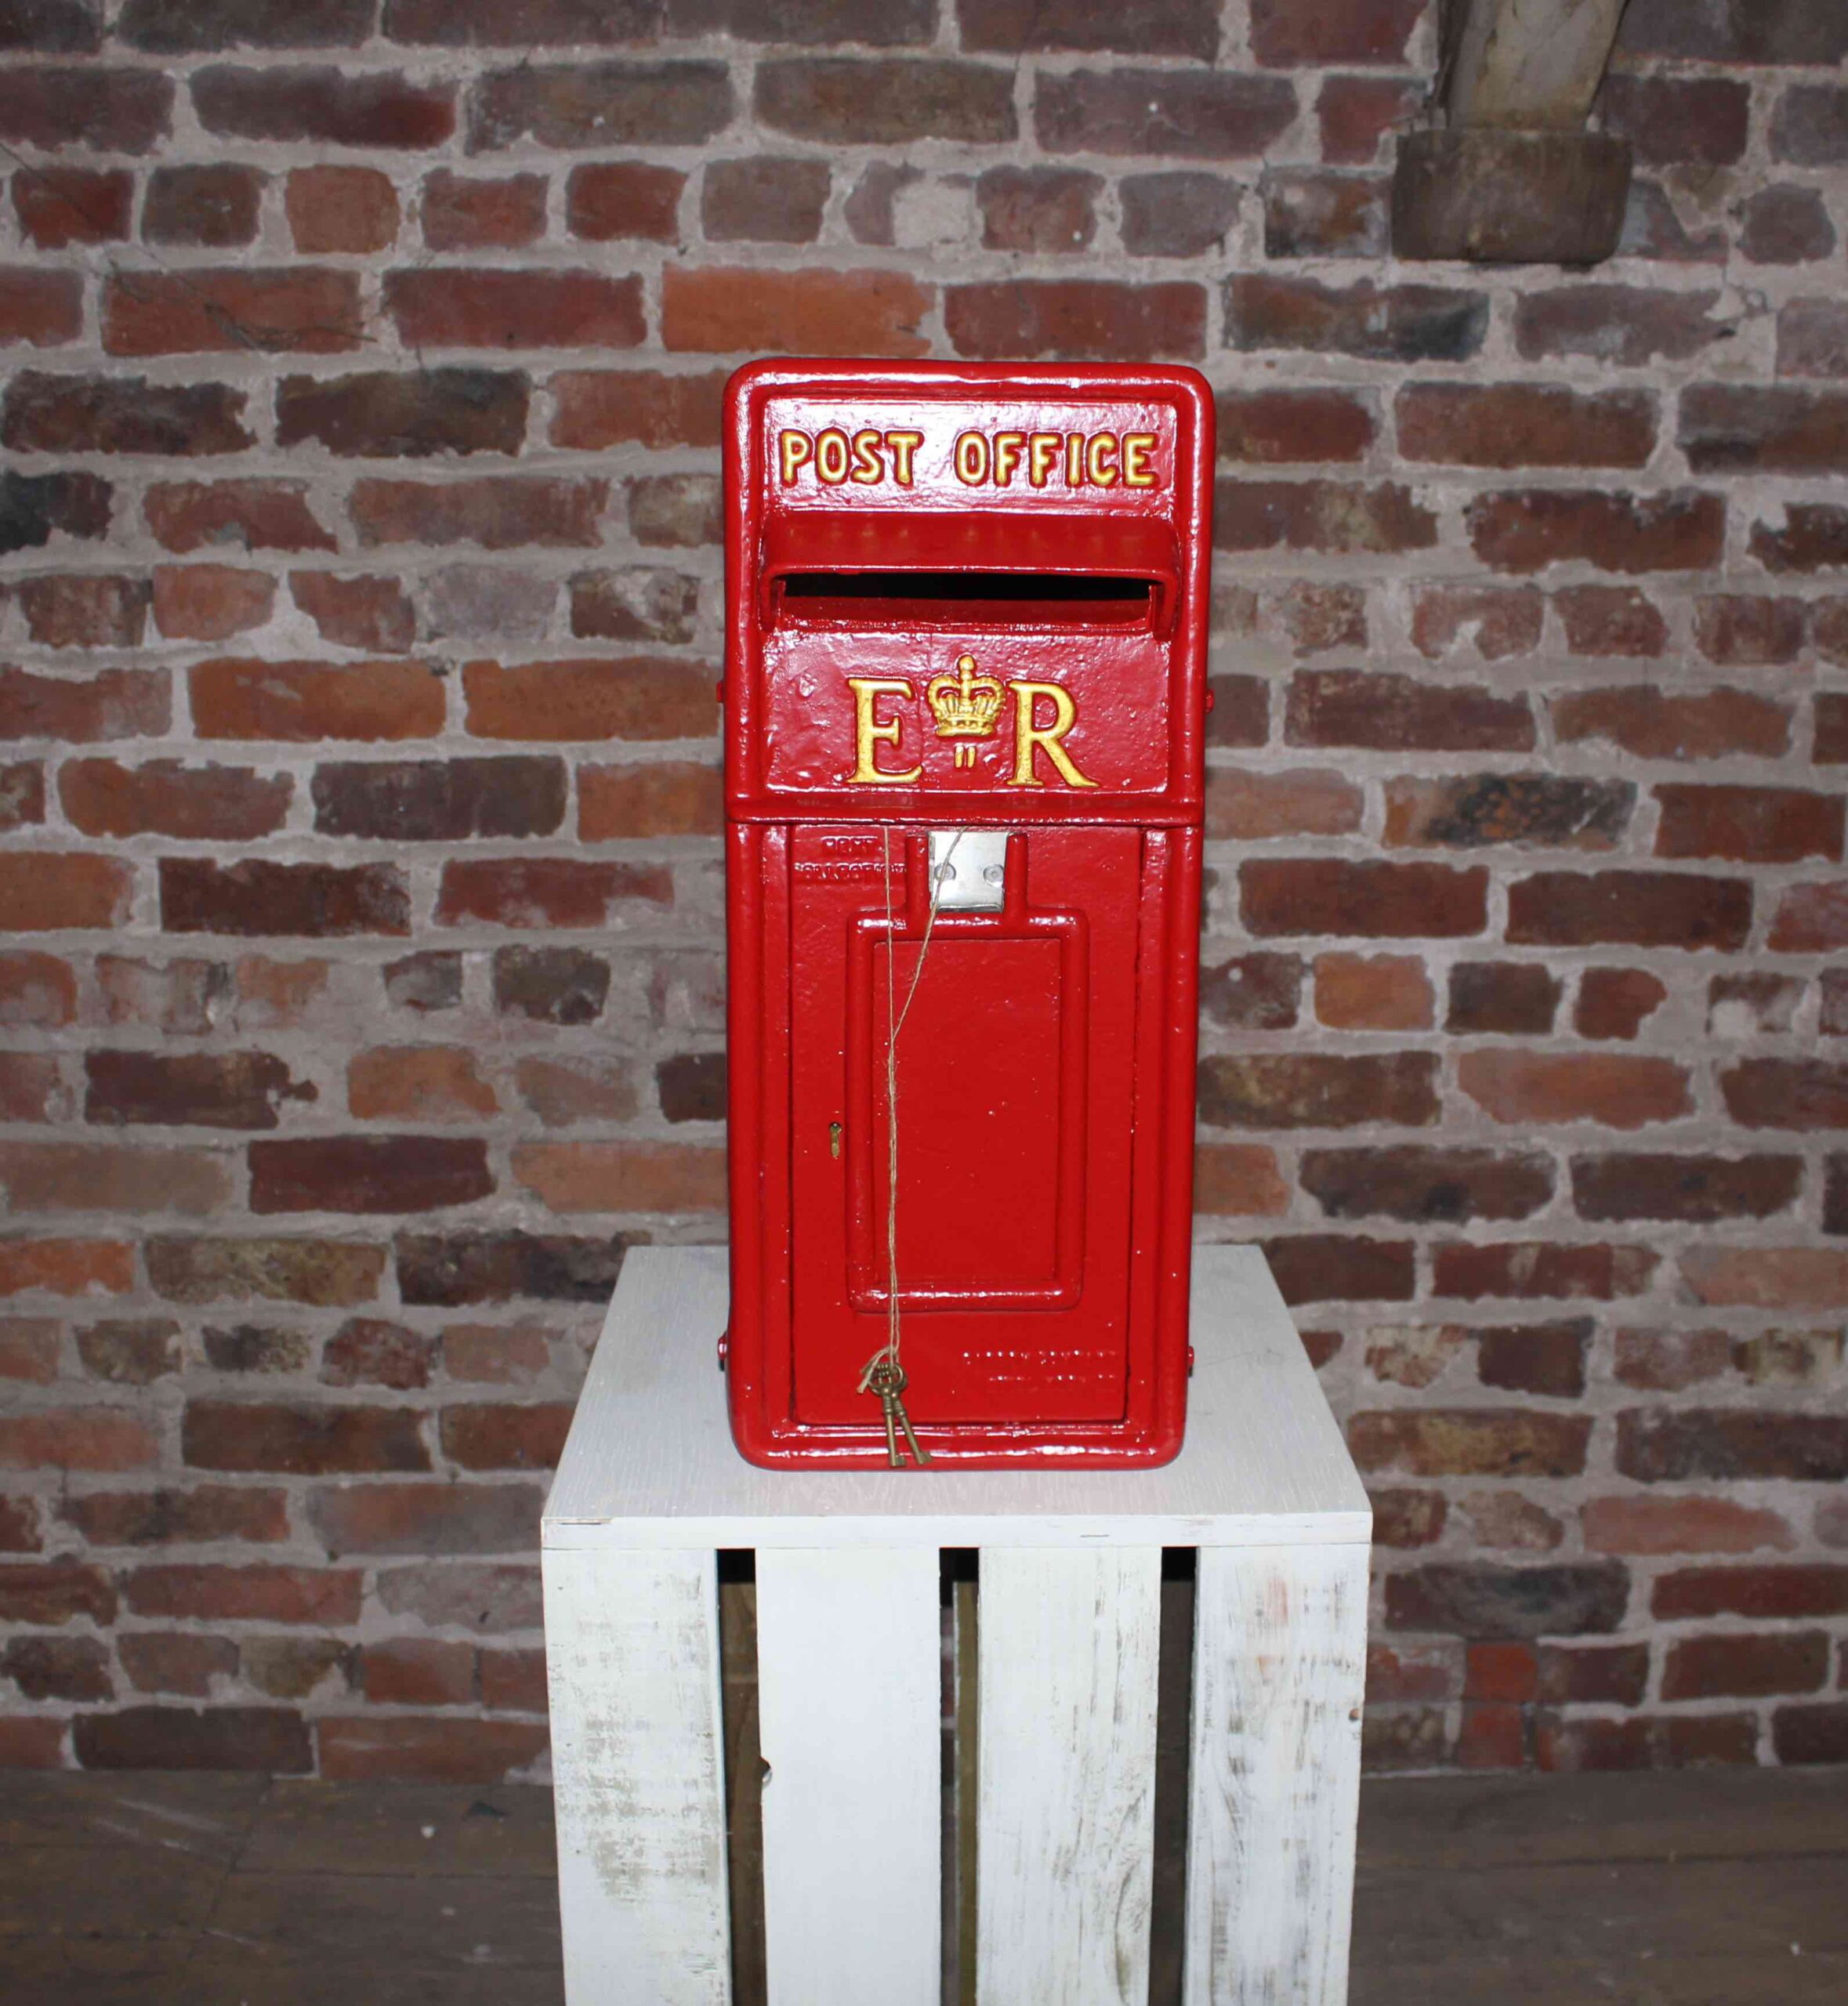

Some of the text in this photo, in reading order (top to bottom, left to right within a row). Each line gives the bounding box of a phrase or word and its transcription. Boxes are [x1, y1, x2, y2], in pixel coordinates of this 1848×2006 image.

[781, 430, 1157, 487] POST OFFICE
[846, 678, 923, 784] E
[1006, 679, 1100, 788] R
